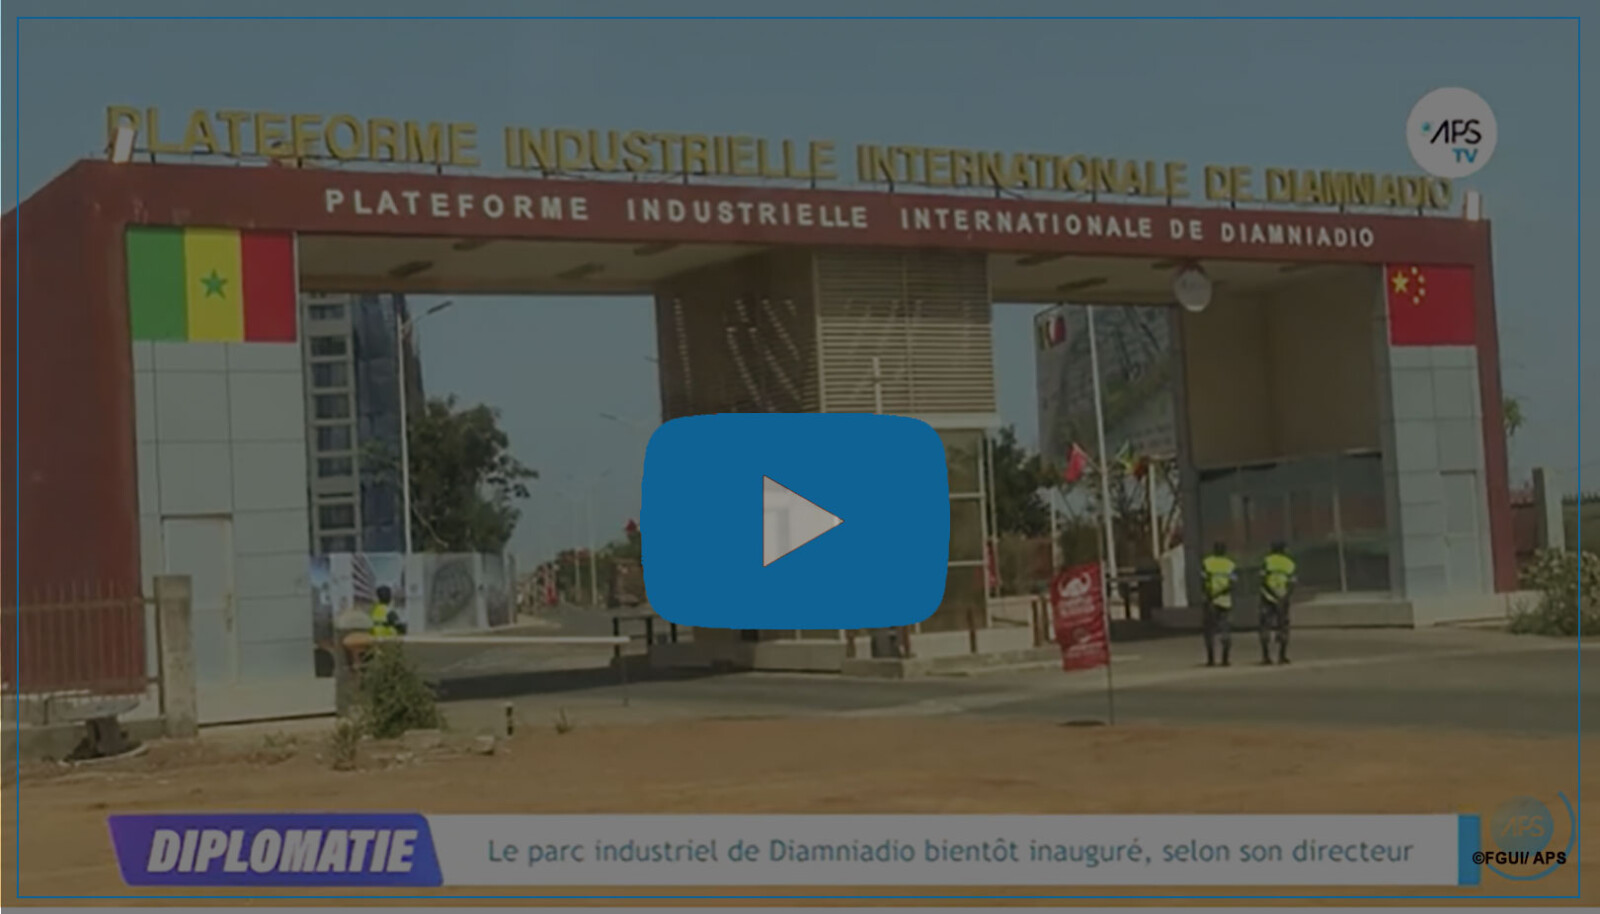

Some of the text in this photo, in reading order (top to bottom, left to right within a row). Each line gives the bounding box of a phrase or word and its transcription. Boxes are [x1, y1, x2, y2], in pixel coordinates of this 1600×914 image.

[106, 105, 1453, 209] PLATEFORME INDUSTRIELLE INTERNATIONALE DE DIAMNIADIO
[325, 188, 1375, 248] PLATEFORME INDUSTRIELLE INTERNATIONALE DE DIAMNIADIO
